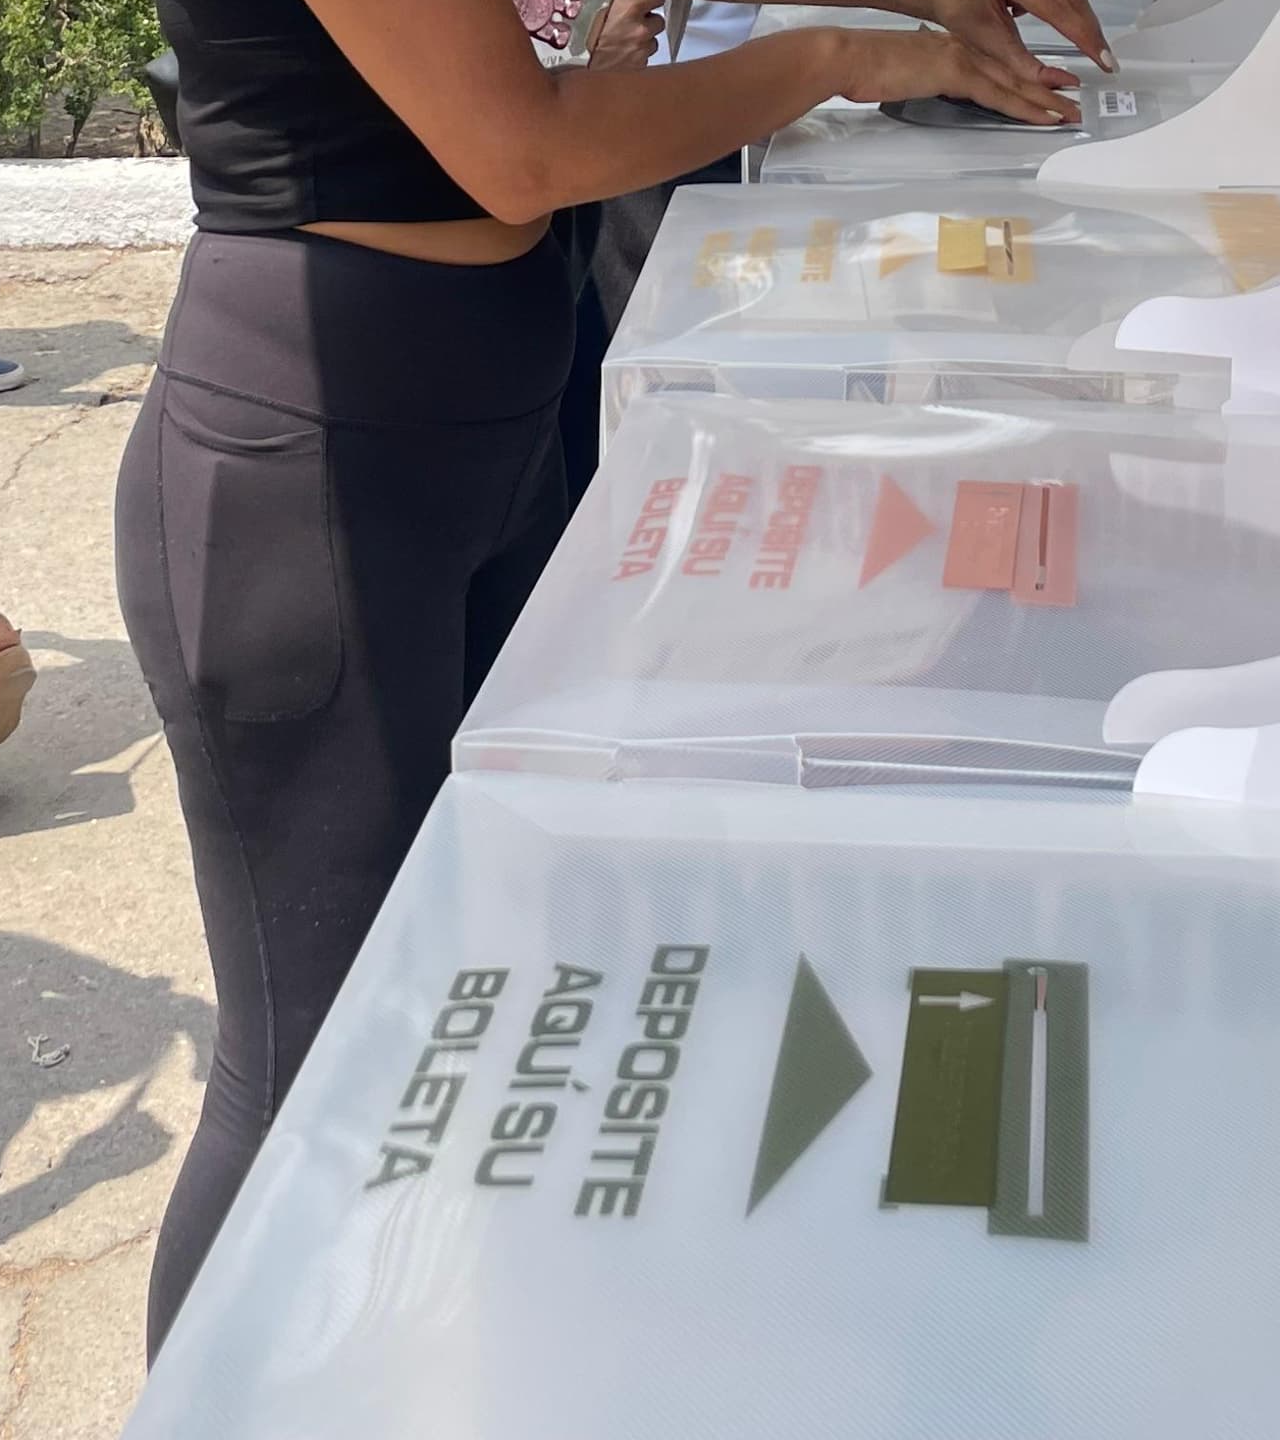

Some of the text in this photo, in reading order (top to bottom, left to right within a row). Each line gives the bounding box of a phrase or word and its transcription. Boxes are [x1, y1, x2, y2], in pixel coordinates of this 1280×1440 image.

[749, 464, 824, 591] DEPOSITE
[363, 967, 511, 1190] BOLETA
[474, 961, 604, 1187] AQUÍ SU
[573, 943, 711, 1217] DEPOSITE
